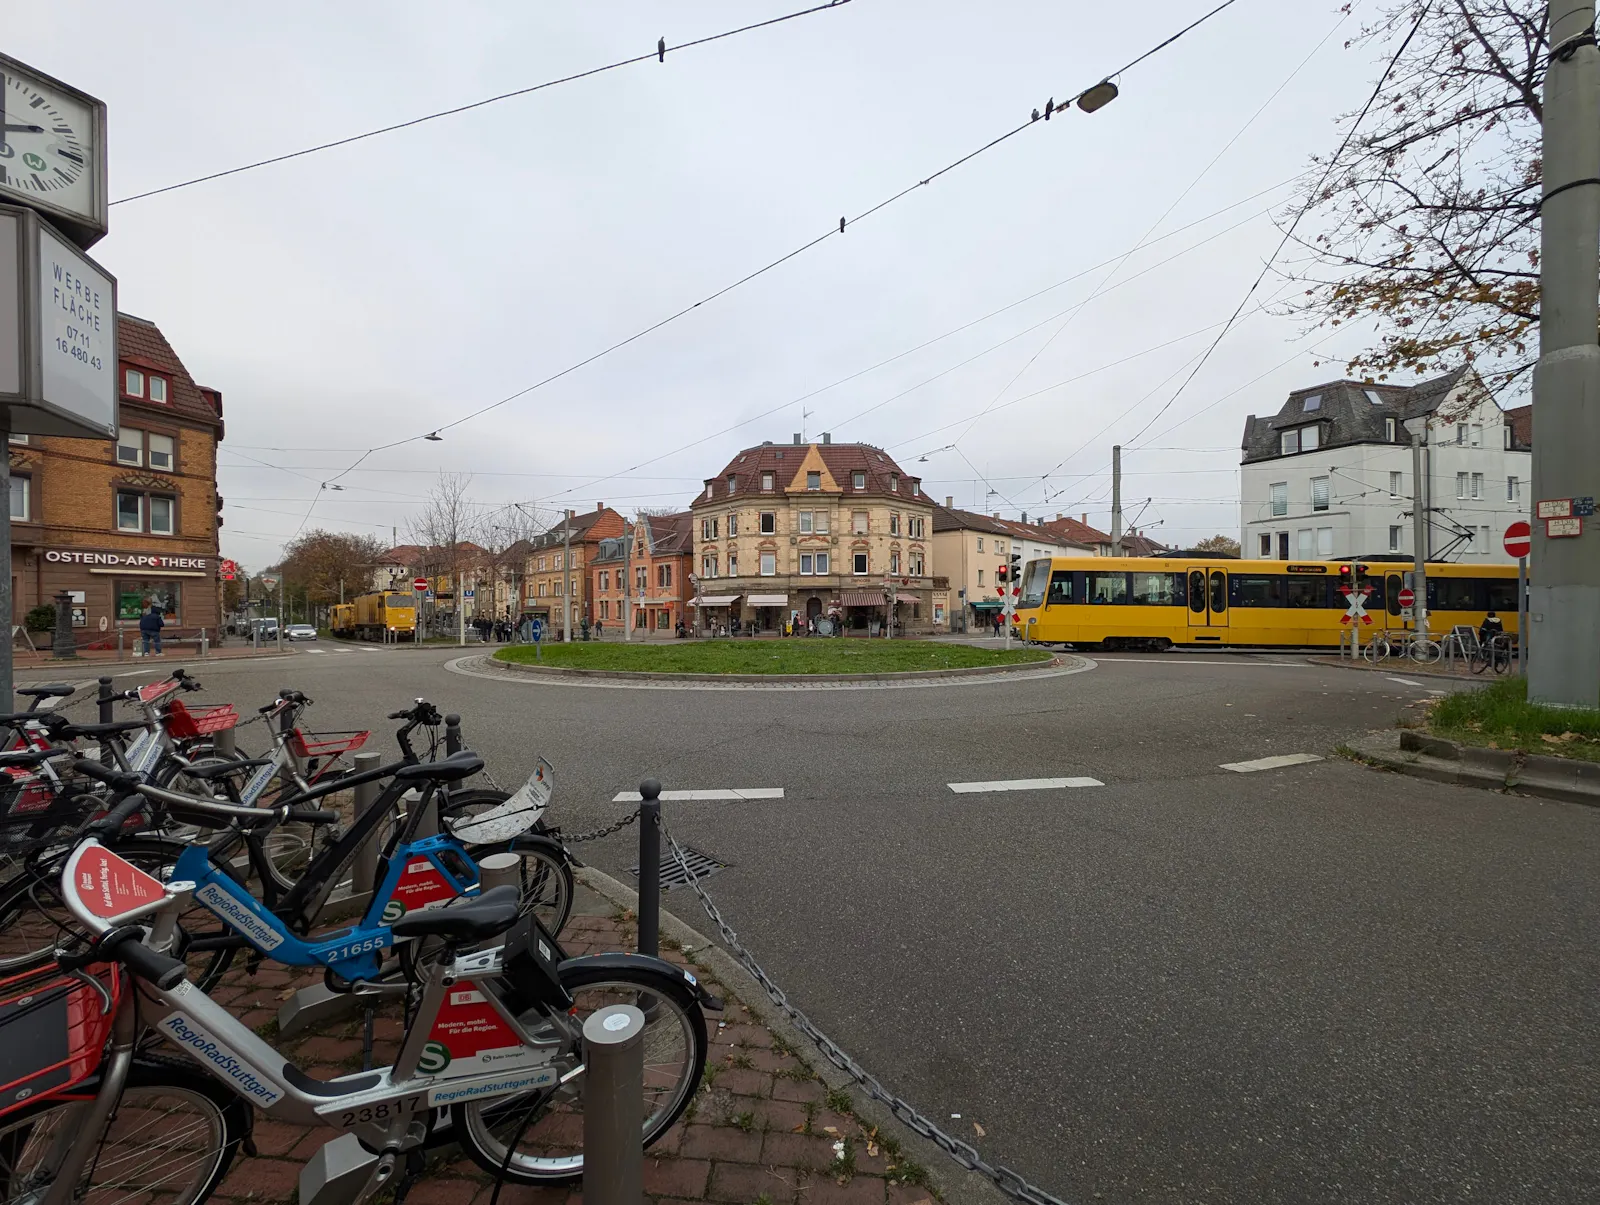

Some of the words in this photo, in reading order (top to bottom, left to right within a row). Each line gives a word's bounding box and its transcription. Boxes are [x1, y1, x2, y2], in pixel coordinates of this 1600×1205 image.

[52, 261, 100, 310] WERBE
[53, 287, 100, 332] FLÄCHE
[56, 337, 68, 353] 16
[70, 345, 88, 364] 480
[90, 356, 102, 370] 43
[45, 551, 206, 569] OSTEND-APOTHEKE
[203, 887, 279, 947] RegioRadStuttgart
[382, 901, 402, 921] S
[327, 936, 385, 963] 21655
[438, 1021, 466, 1029] Modern,
[467, 1018, 487, 1026] mobil.
[473, 1024, 498, 1032] Region.
[166, 1017, 278, 1103] RegioRadStuttgart
[434, 1074, 551, 1102] RegioRadStuttgart.de
[342, 1096, 421, 1128] 23817
